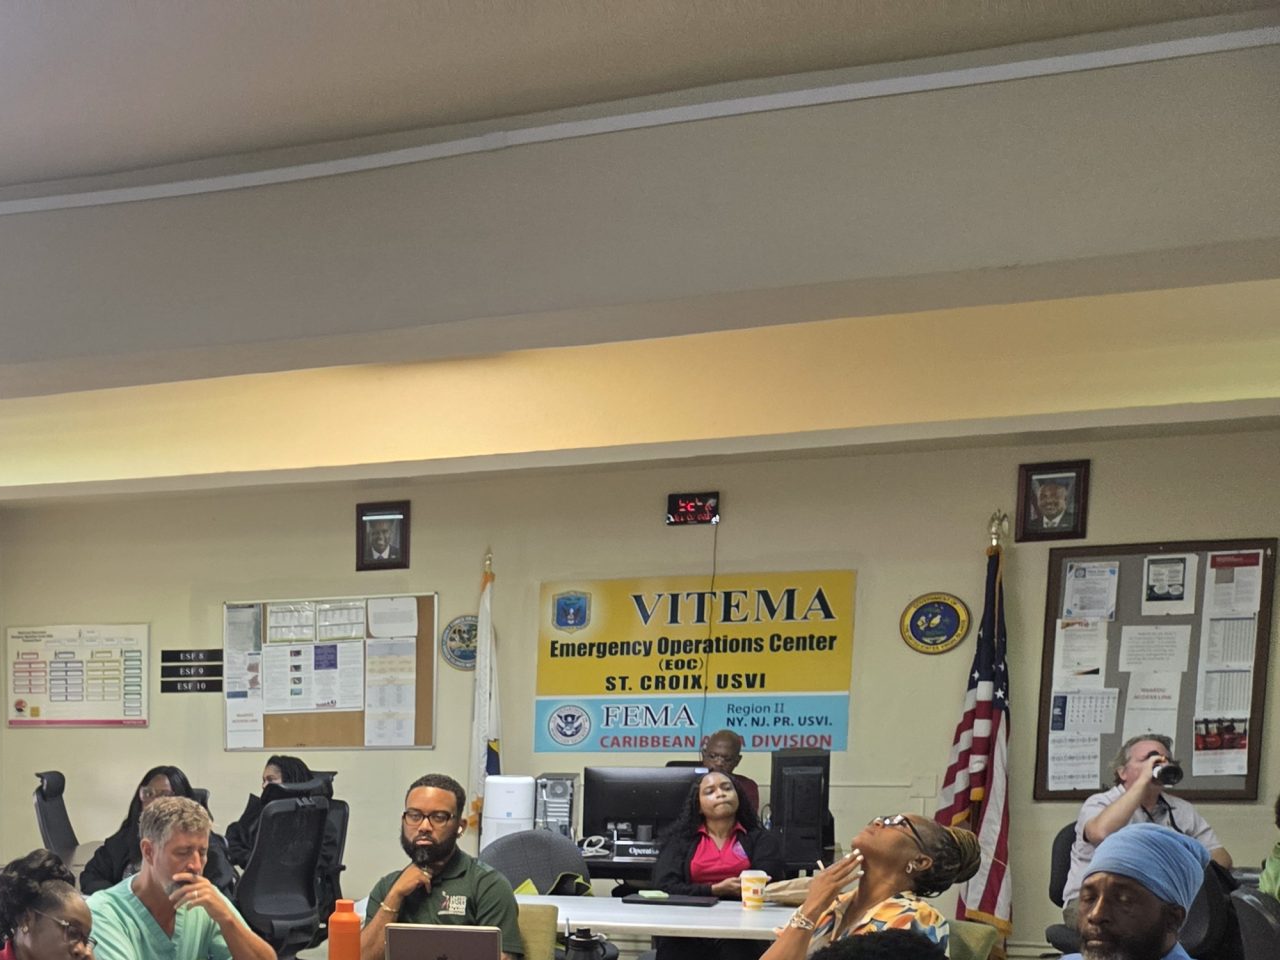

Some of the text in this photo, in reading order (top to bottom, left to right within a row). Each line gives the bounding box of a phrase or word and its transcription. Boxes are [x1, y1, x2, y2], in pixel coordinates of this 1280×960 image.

[631, 587, 837, 626] VITEMA
[550, 633, 838, 658] Emergency Operations Center
[180, 652, 196, 660] ESF
[180, 667, 196, 675] ESF
[658, 658, 704, 671] (EOC)
[177, 682, 206, 690] ESF 10
[605, 673, 766, 691] ST. CROIX, USVI
[726, 702, 785, 716] Region II
[601, 704, 698, 728] FEMA
[726, 716, 833, 727] NY. NJ. PR. USVI.
[600, 735, 695, 748] CARIBBEAN
[751, 735, 832, 748] DIVISION
